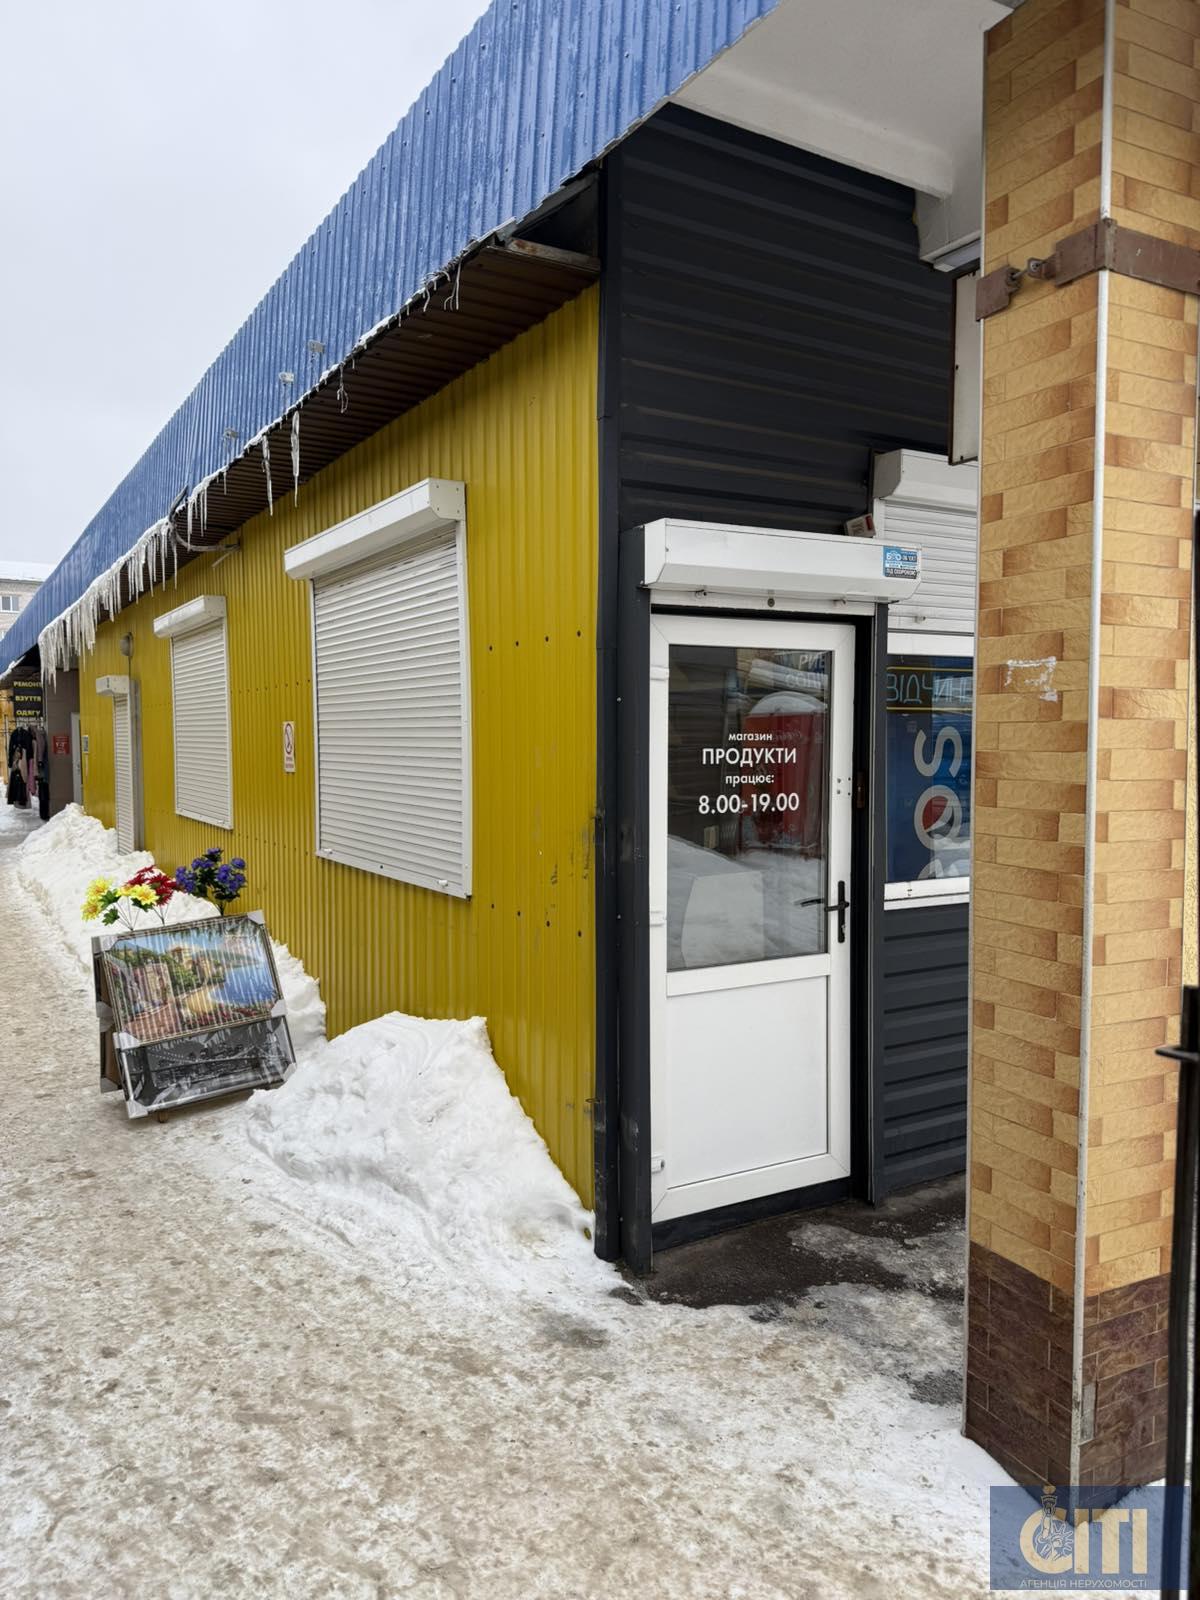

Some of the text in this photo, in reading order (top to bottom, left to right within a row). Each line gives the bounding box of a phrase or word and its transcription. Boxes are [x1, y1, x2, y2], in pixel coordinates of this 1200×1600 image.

[728, 733, 773, 741] магазин
[702, 747, 797, 768] ПРОДУКТИ
[725, 775, 775, 787] працює:
[698, 793, 800, 815] 8.00-19.00
